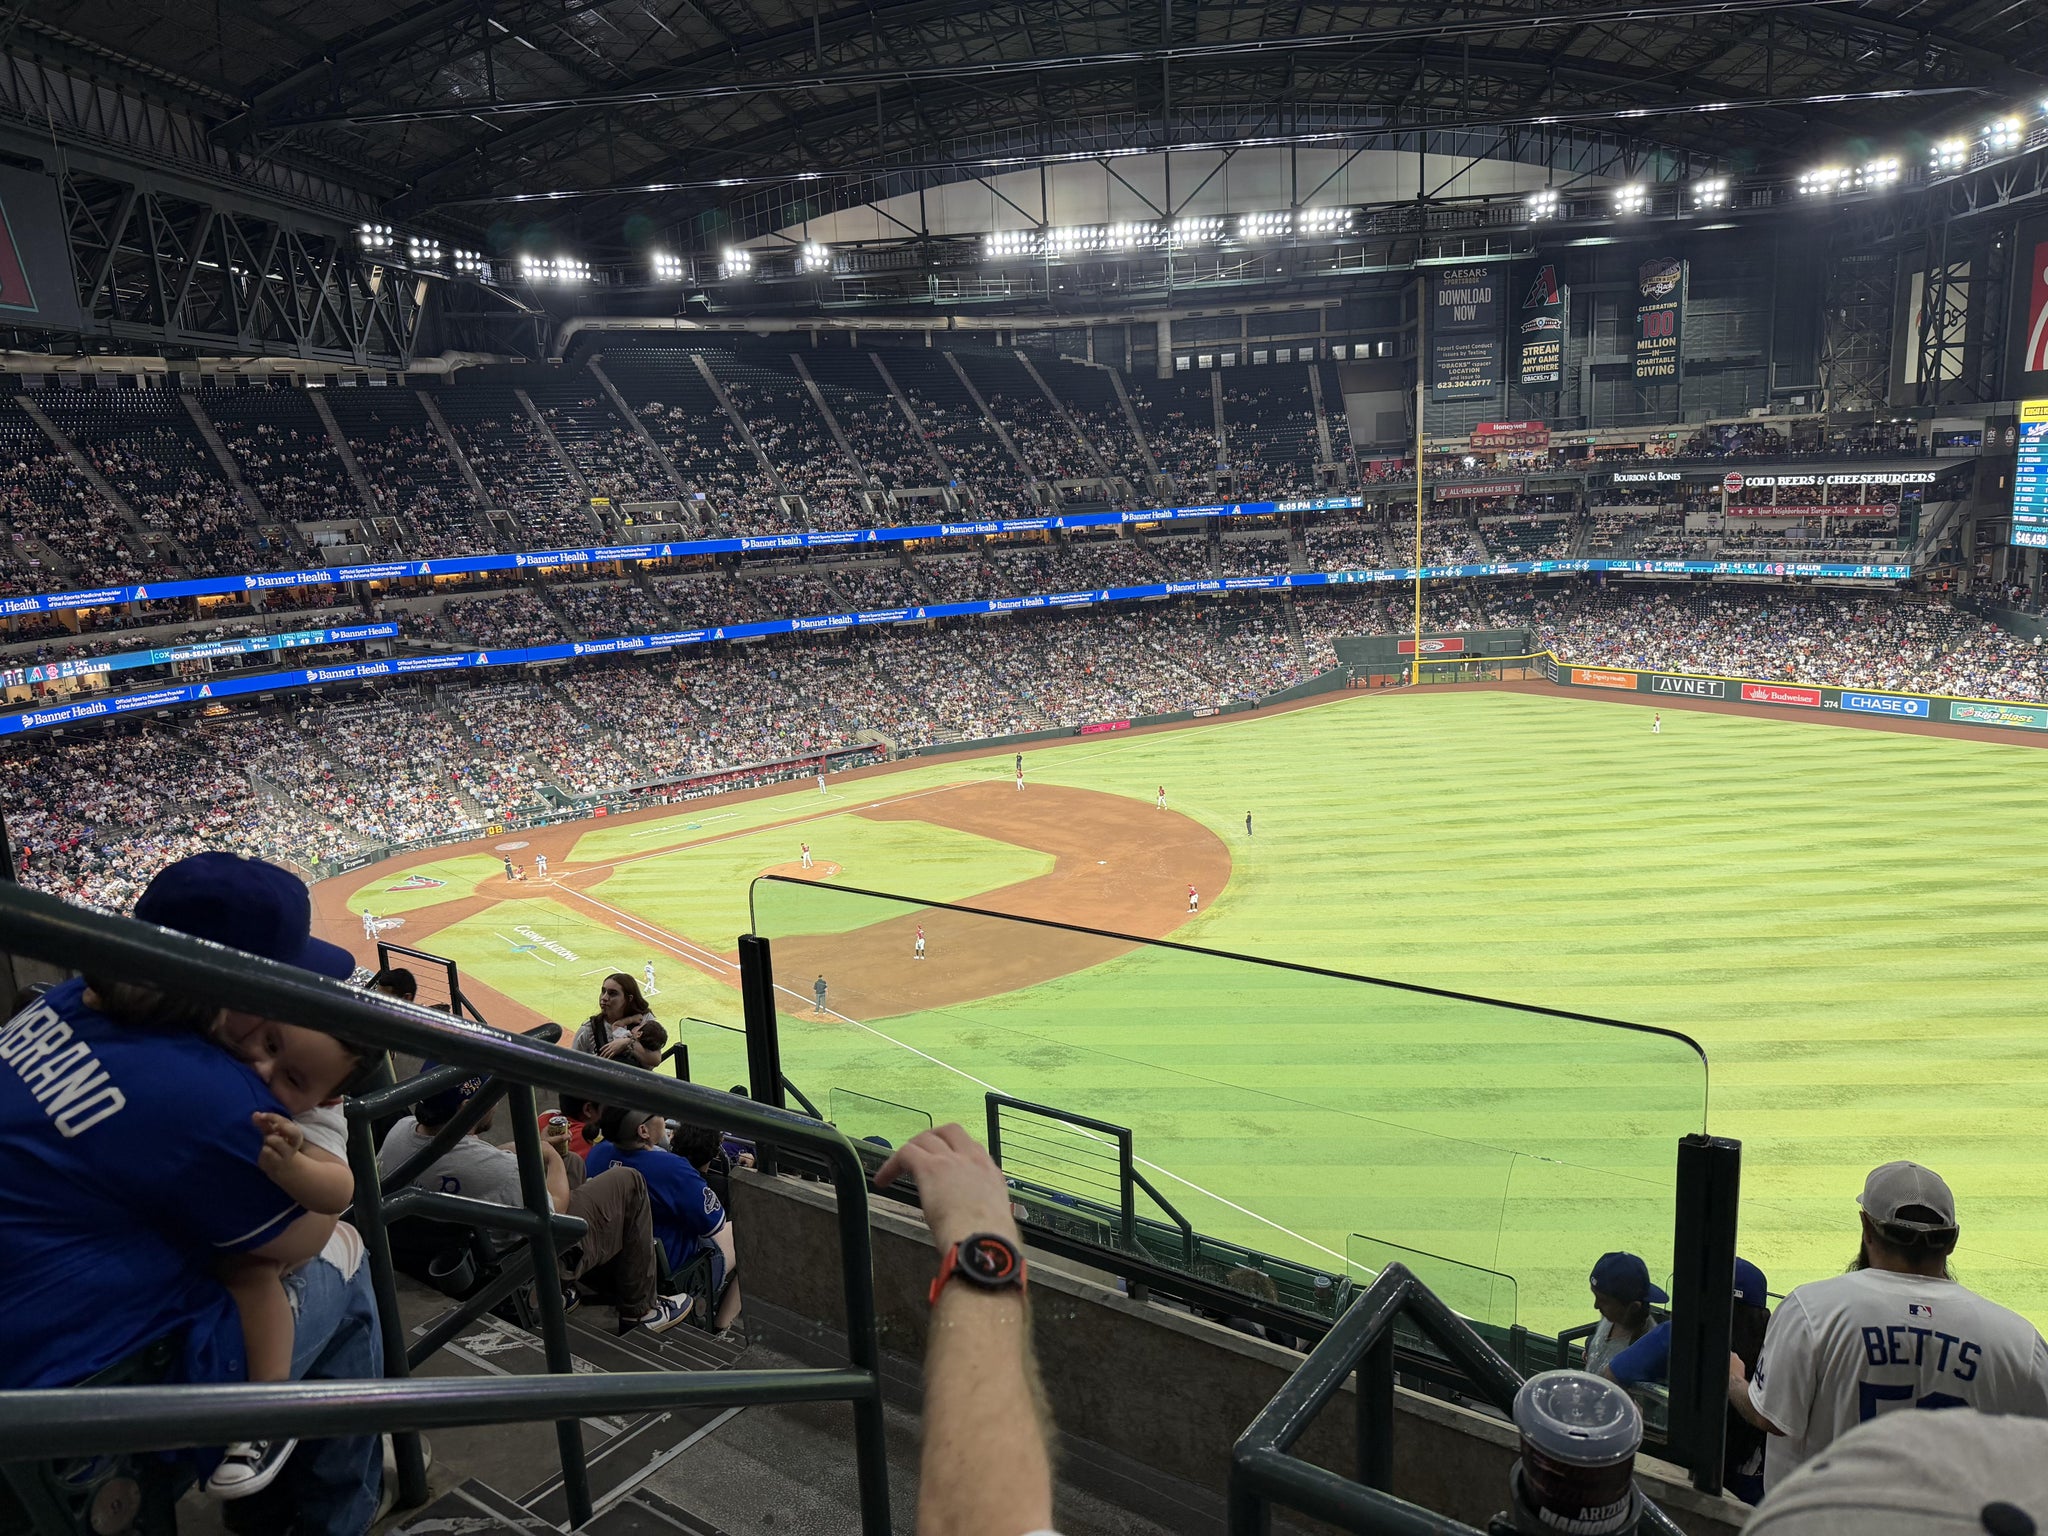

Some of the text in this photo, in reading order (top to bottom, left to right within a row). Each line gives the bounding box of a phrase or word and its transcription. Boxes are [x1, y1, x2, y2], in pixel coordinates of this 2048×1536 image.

[1444, 268, 1488, 278] CAESARS
[1439, 288, 1491, 306] DOWNLOAD
[1454, 305, 1476, 321] NOW
[1639, 302, 1678, 312] CELEBRATING
[1637, 337, 1676, 350] MILLION
[1523, 344, 1559, 356] STREAM
[1522, 355, 1559, 365] ANY GAME
[1637, 356, 1675, 365] CHARITABLE
[1522, 364, 1559, 373] ANYWHERE
[1637, 364, 1675, 377] GIVING
[1437, 379, 1491, 389] 623.304.0777
[1493, 422, 1527, 430] Honeywell
[1649, 472, 1656, 480] &
[1746, 477, 1775, 486] COLD
[1778, 476, 1815, 486] BEERS
[1817, 476, 1825, 485] &
[1827, 473, 1936, 484] CHEESEBURGERS
[1152, 510, 1172, 519] Health
[1758, 507, 1771, 515] Your
[1773, 507, 1809, 515] Neighborhood
[1811, 507, 1831, 515] Burger
[950, 525, 974, 533] Banner
[975, 523, 997, 532] Health
[751, 538, 777, 548] Banner
[778, 536, 802, 546] Health
[2015, 531, 2046, 546] $46,458
[528, 554, 559, 564] Banner
[560, 552, 588, 561] Health
[258, 571, 332, 586] Banner Health
[1197, 581, 1219, 589] Health
[6, 599, 40, 612] Health
[1022, 598, 1044, 606] Health
[801, 619, 827, 628] Banner
[829, 616, 852, 626] Health
[340, 626, 392, 638] Banner Health
[585, 638, 644, 652] Banner Health
[171, 646, 246, 660] FOUR-SEAM FASTBALL
[76, 663, 111, 674] GALLEN
[320, 669, 356, 679] Banner
[357, 663, 389, 675] Health
[1660, 678, 1717, 695] AVNET
[1771, 692, 1813, 703] Budweiser
[1851, 697, 1902, 711] CHASE
[35, 702, 107, 725] Banner Health
[1974, 710, 2000, 719] Baja
[2000, 713, 2034, 722] Blast
[488, 825, 503, 835] 08
[1862, 1326, 1982, 1382] BETTS
